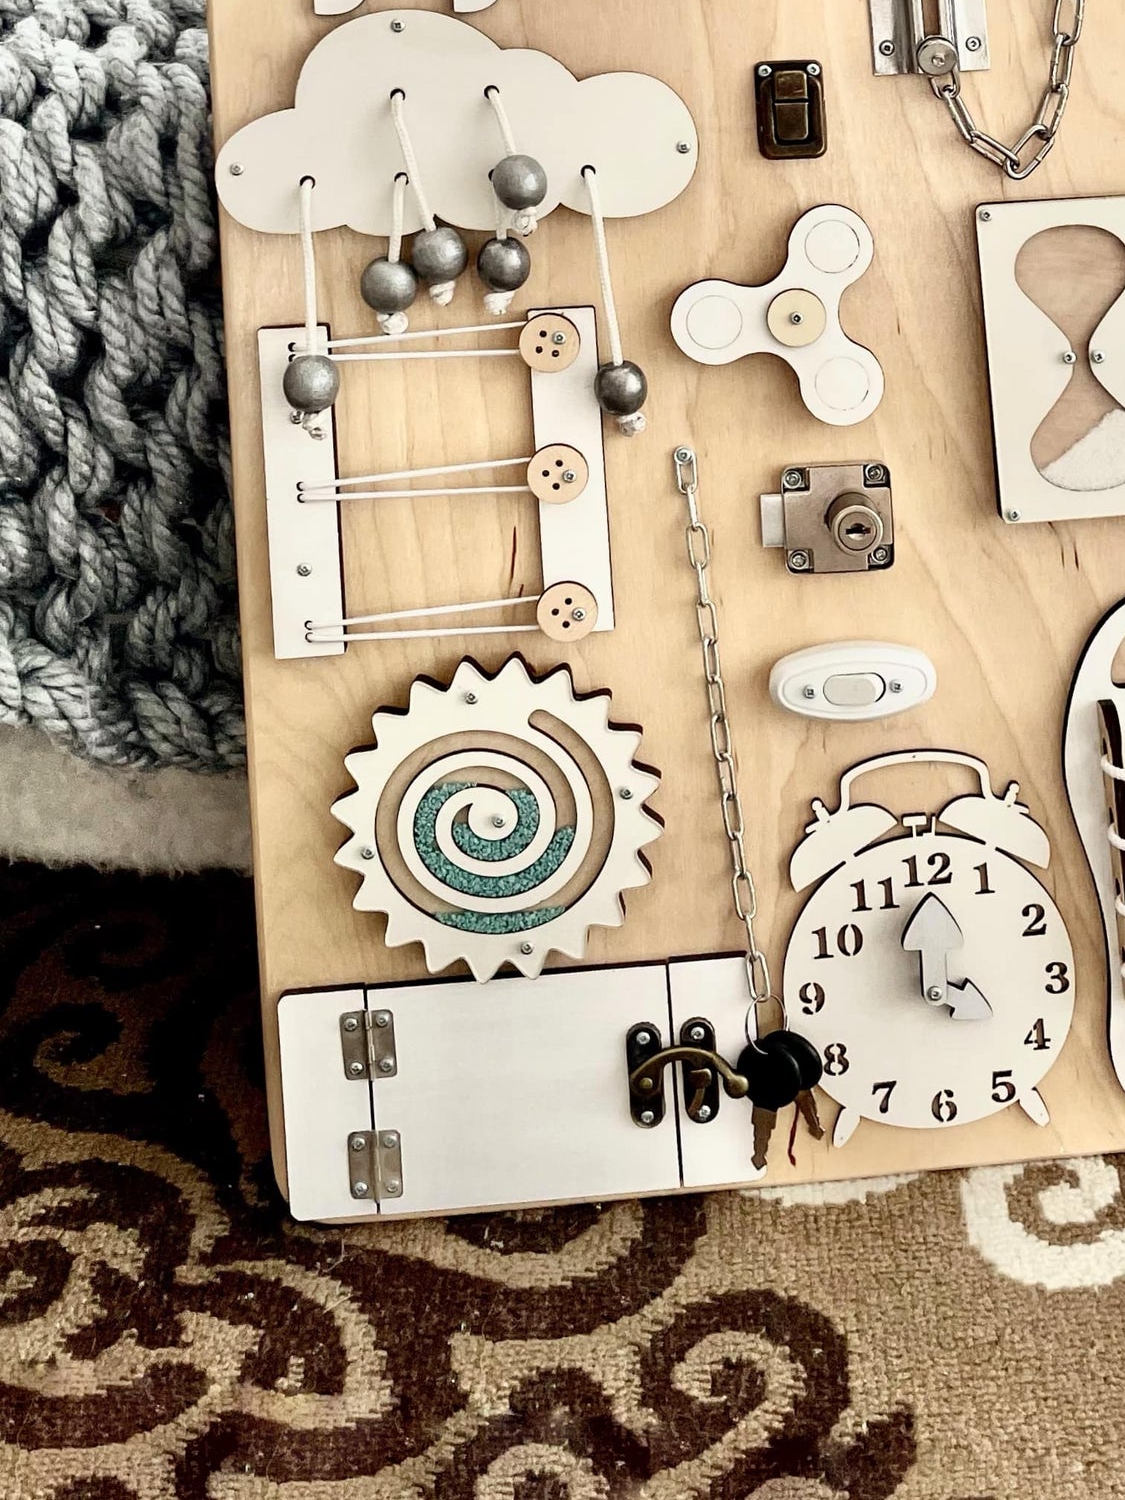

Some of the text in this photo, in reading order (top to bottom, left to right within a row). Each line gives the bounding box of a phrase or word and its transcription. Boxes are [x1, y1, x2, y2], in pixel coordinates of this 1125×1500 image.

[902, 852, 953, 888] 12
[973, 862, 995, 895] 1
[850, 876, 900, 912] 11
[1021, 904, 1047, 937] 2
[812, 924, 863, 959] 10
[1044, 962, 1069, 994] 3
[799, 982, 825, 1015] 9
[1024, 1019, 1050, 1050] 4
[823, 1043, 849, 1076] 8
[872, 1081, 897, 1113] 7
[991, 1070, 1016, 1103] 5
[932, 1089, 957, 1122] 6
